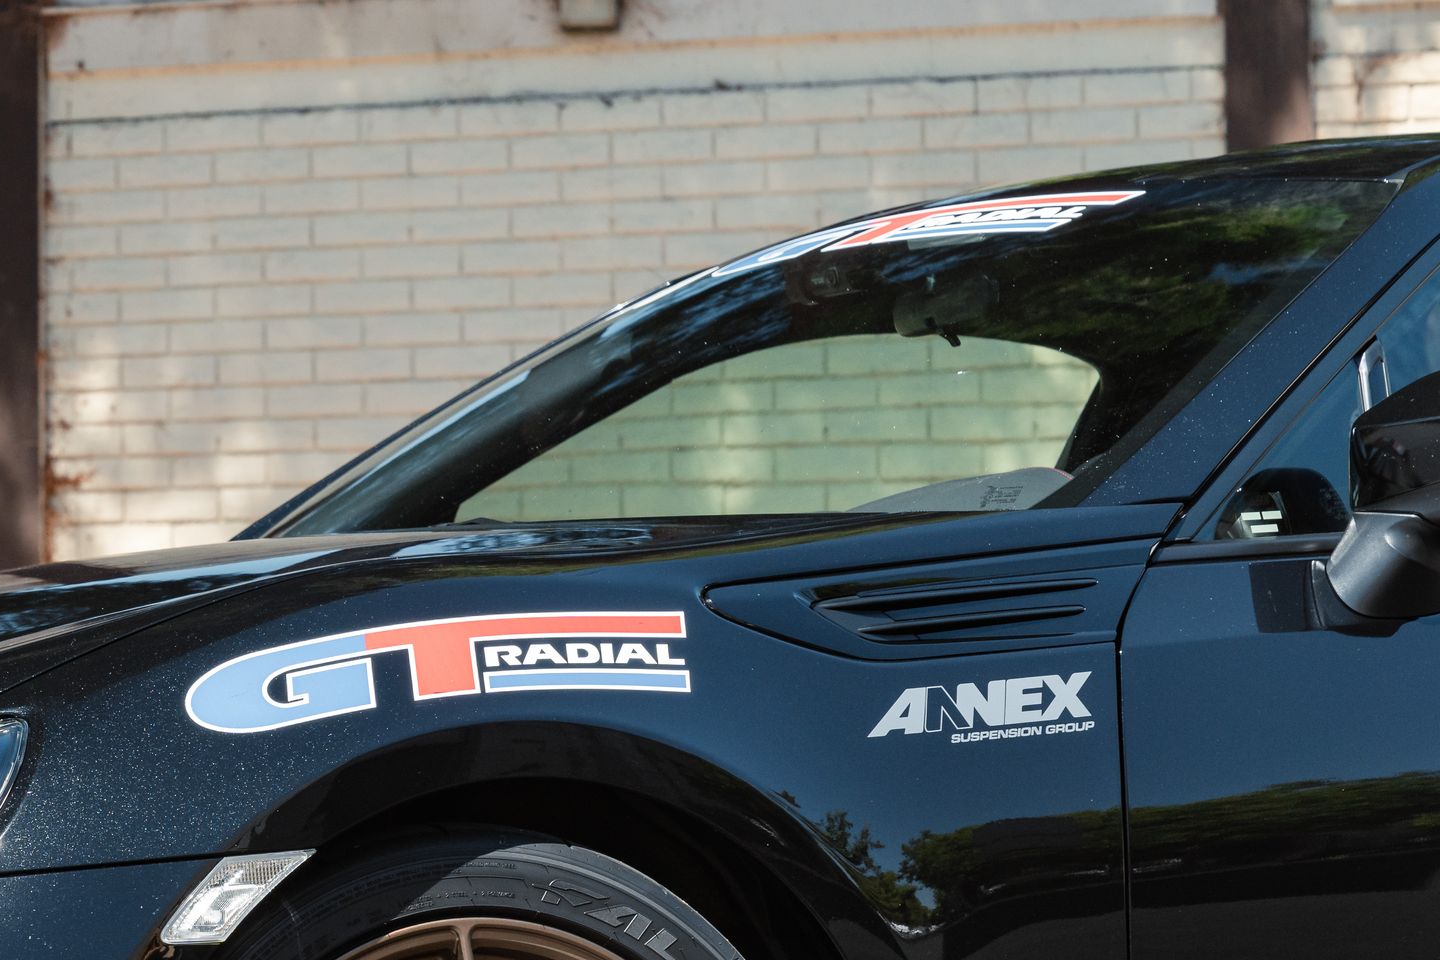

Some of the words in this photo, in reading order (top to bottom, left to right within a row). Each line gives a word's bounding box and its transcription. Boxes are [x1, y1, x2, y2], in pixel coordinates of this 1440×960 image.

[185, 610, 686, 733] GT
[484, 643, 685, 667] RADIAL
[867, 671, 1092, 738] ANNEX
[951, 726, 1043, 744] SUSPENSION
[1045, 720, 1095, 735] GROUP
